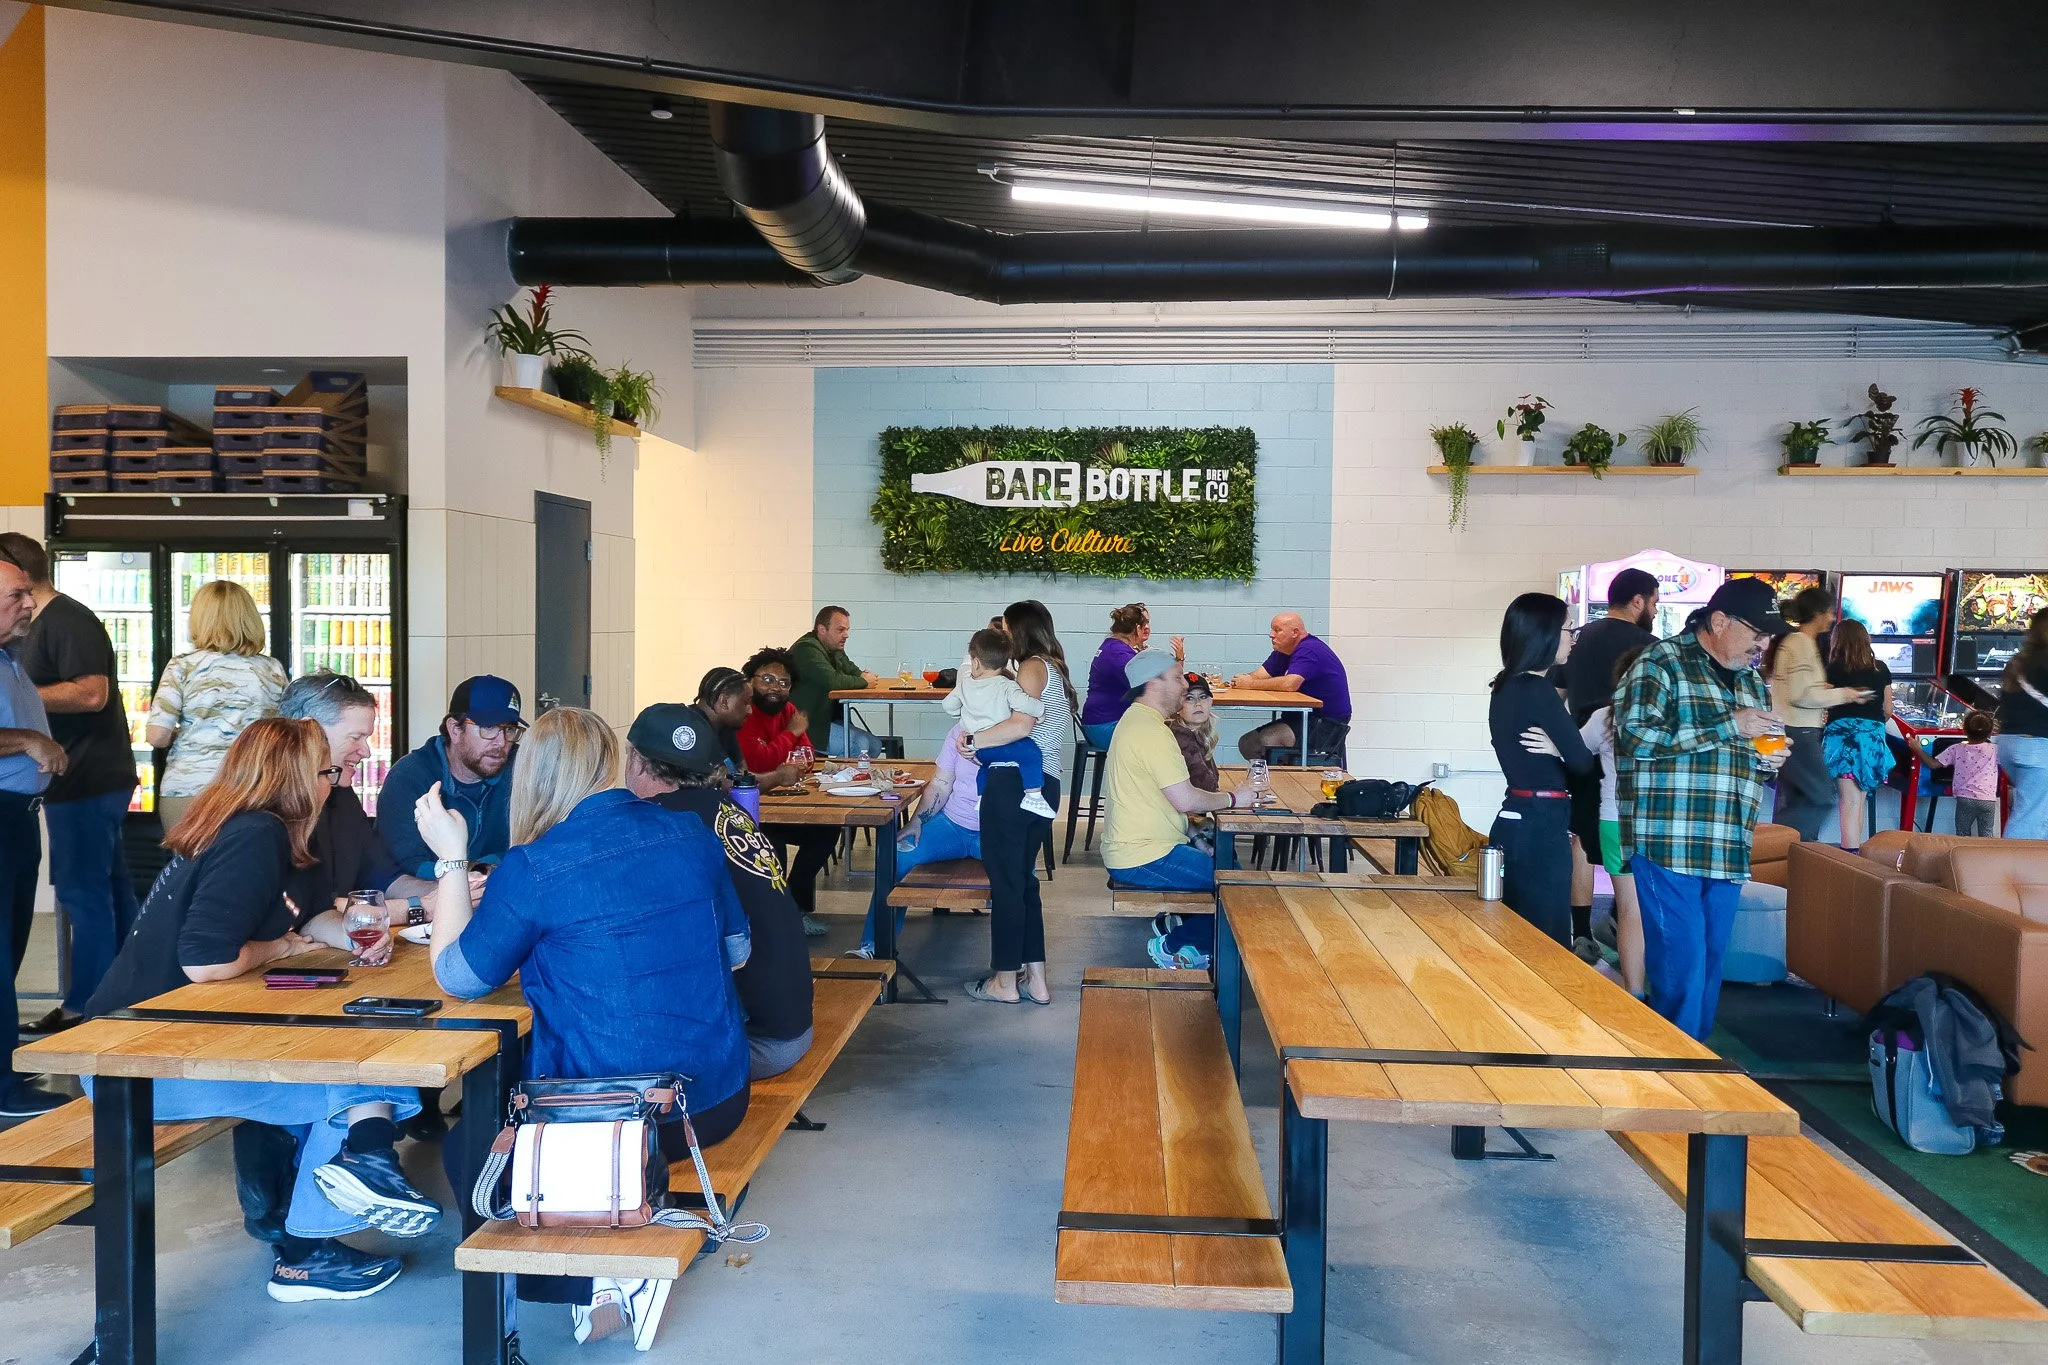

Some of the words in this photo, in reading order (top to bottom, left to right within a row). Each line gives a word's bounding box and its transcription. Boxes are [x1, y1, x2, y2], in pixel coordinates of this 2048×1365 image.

[1206, 469, 1230, 481] BREW
[986, 467, 1073, 501] BARE
[1086, 468, 1202, 502] BOTTLE
[999, 532, 1045, 553] Live
[1868, 581, 1914, 593] JAWS
[274, 1264, 309, 1281] HOKA
